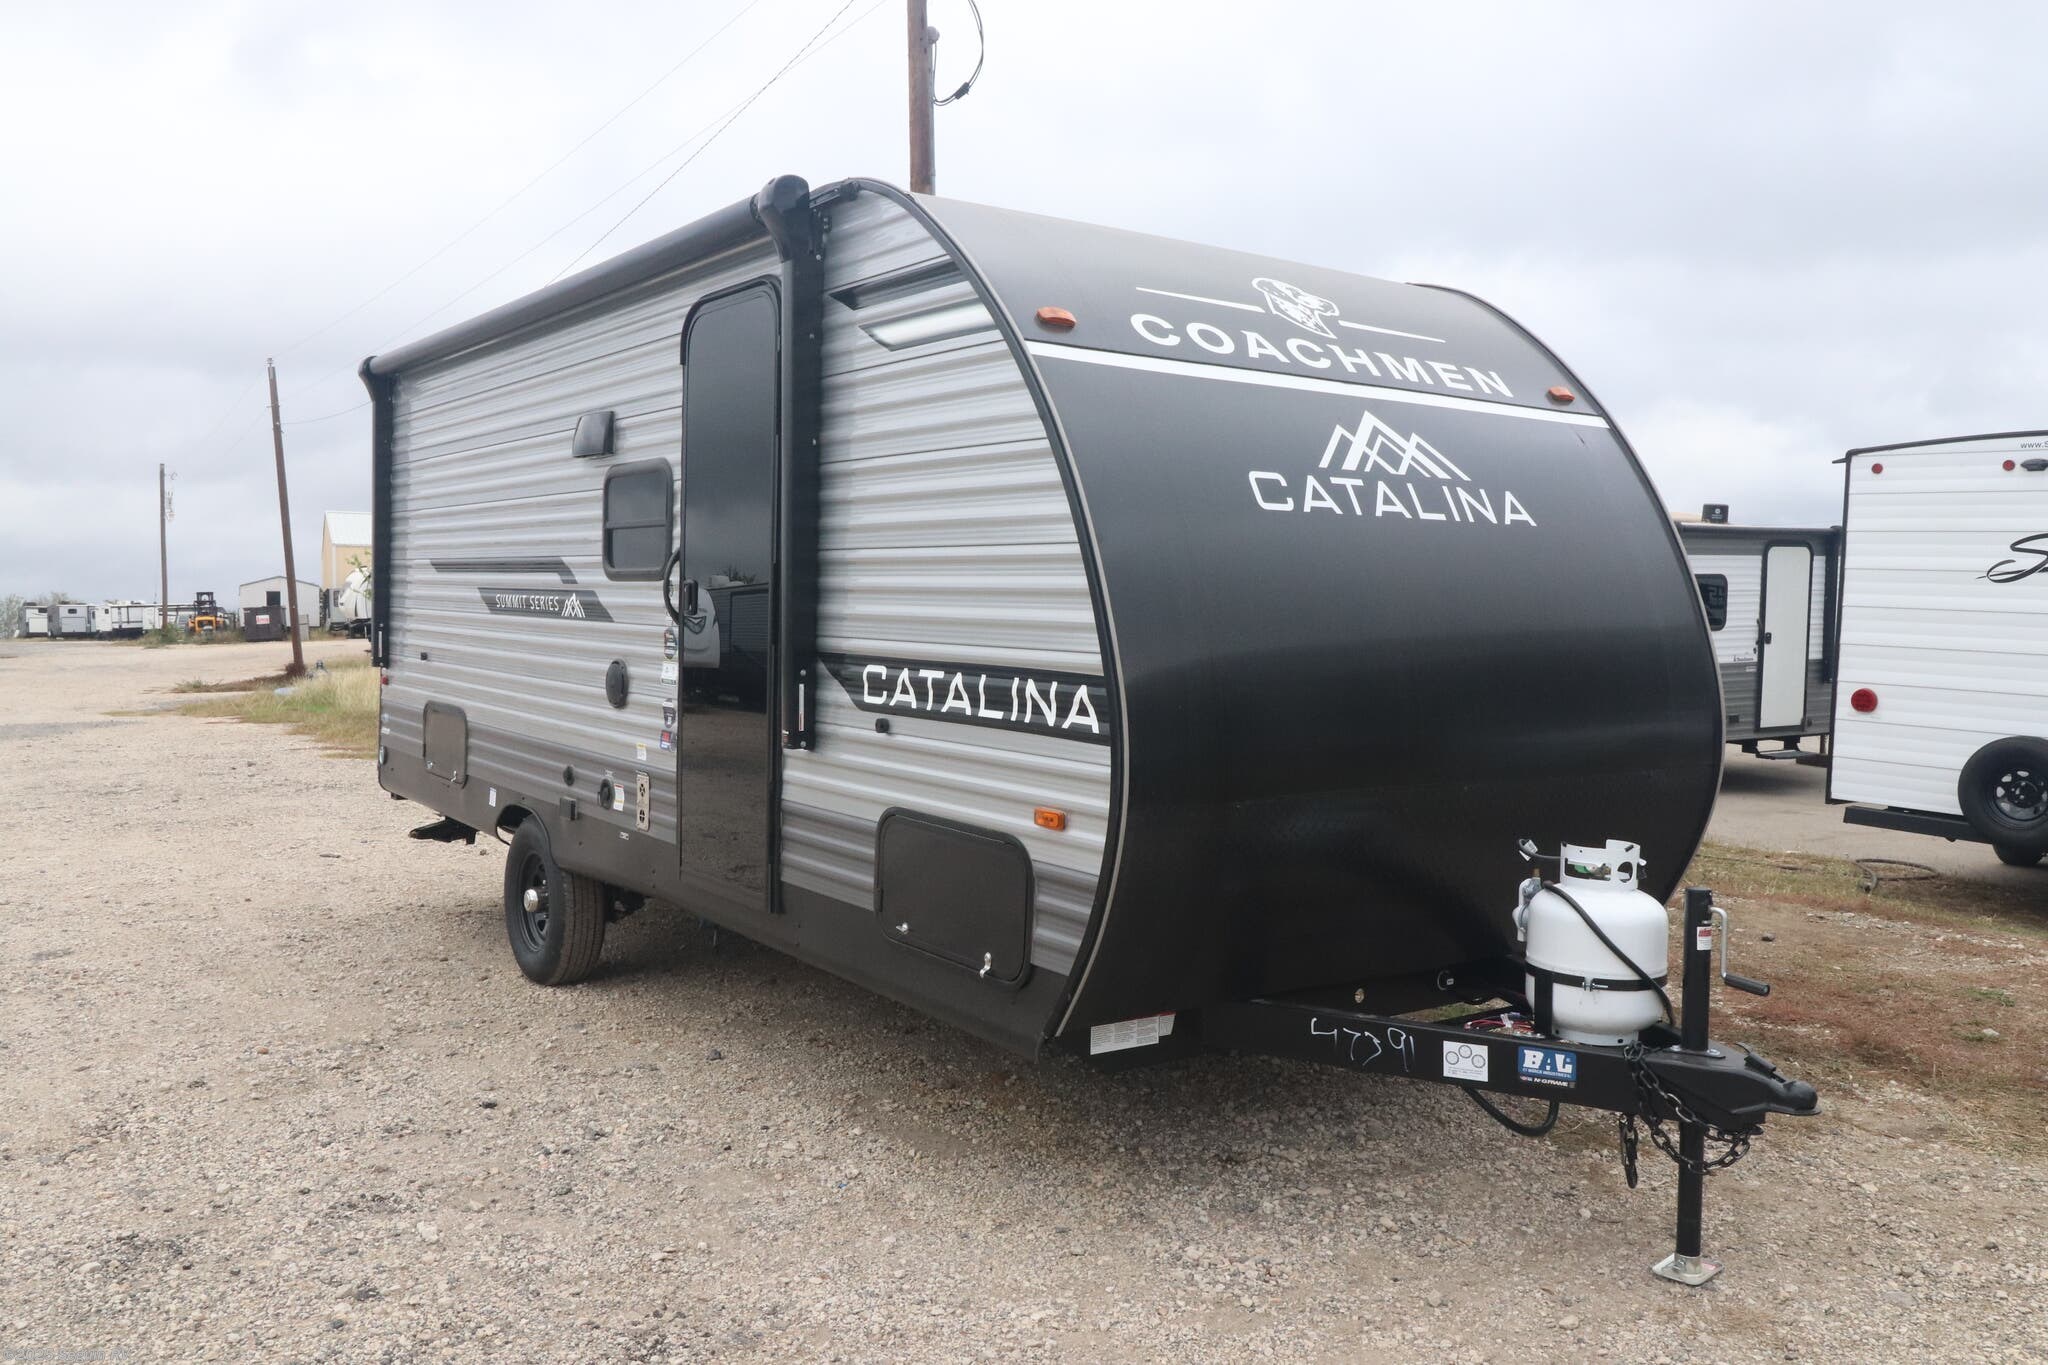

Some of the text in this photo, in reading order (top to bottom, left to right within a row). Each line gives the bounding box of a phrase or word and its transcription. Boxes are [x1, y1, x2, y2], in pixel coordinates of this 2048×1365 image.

[1131, 313, 1514, 398] COACHMEN
[1249, 471, 1537, 527] CATALINA
[495, 594, 560, 611] SUMMIT SERIES
[862, 664, 1100, 734] CATALINA
[1523, 1049, 1573, 1074] BAL
